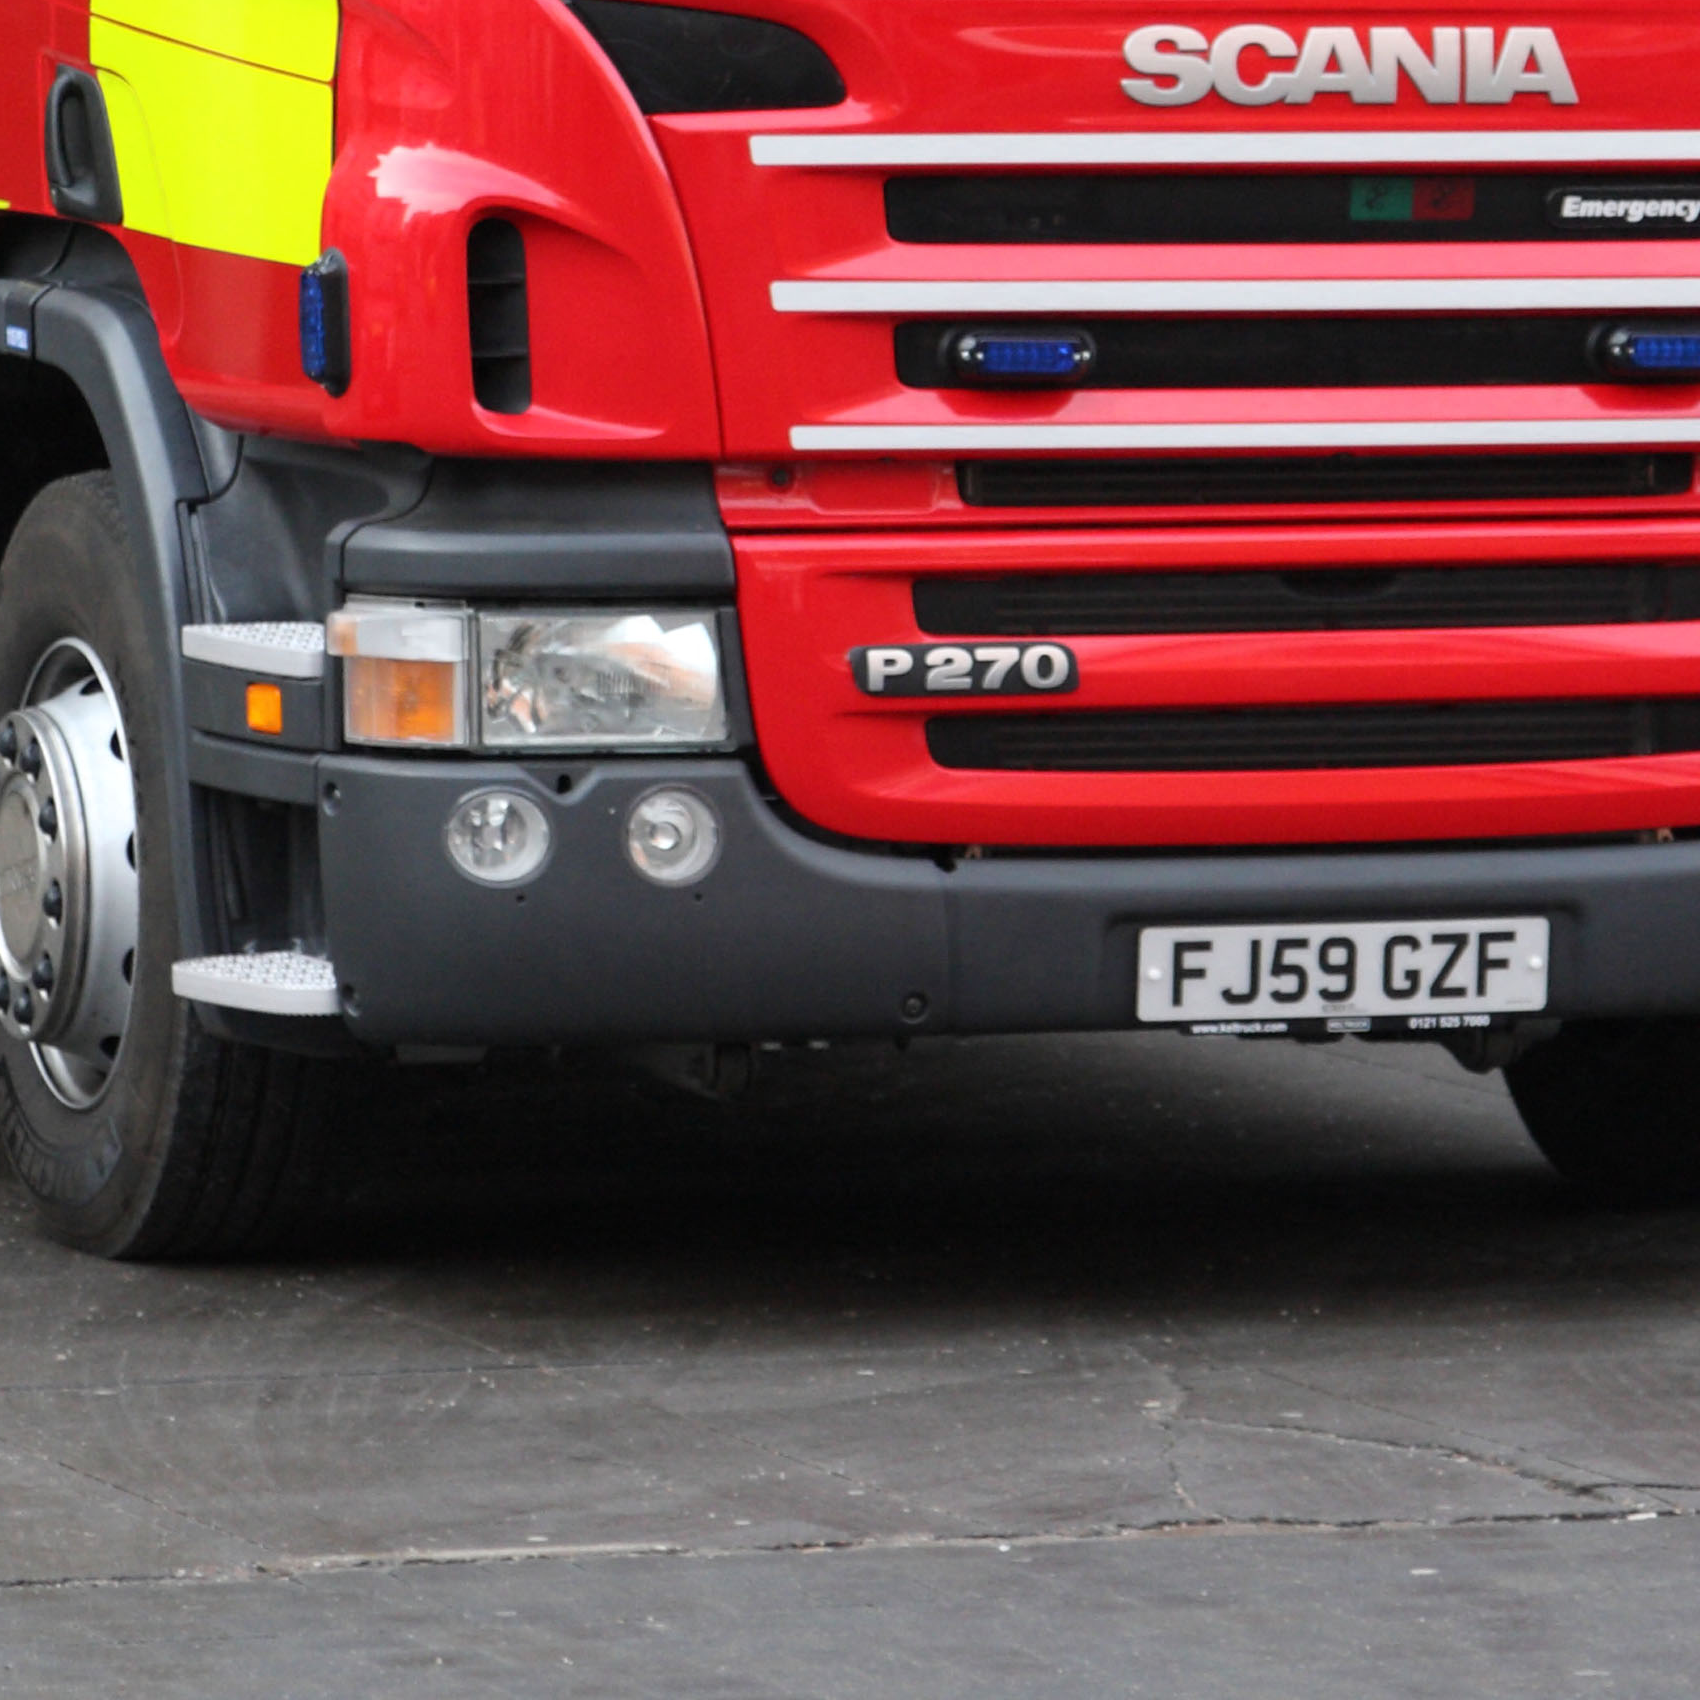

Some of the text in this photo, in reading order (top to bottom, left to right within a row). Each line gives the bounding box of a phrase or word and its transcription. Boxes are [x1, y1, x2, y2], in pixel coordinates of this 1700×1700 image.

[1119, 22, 1579, 107] SCANIA
[865, 643, 1070, 693] P 270
[1170, 930, 1517, 1008] FJ59 GZF
